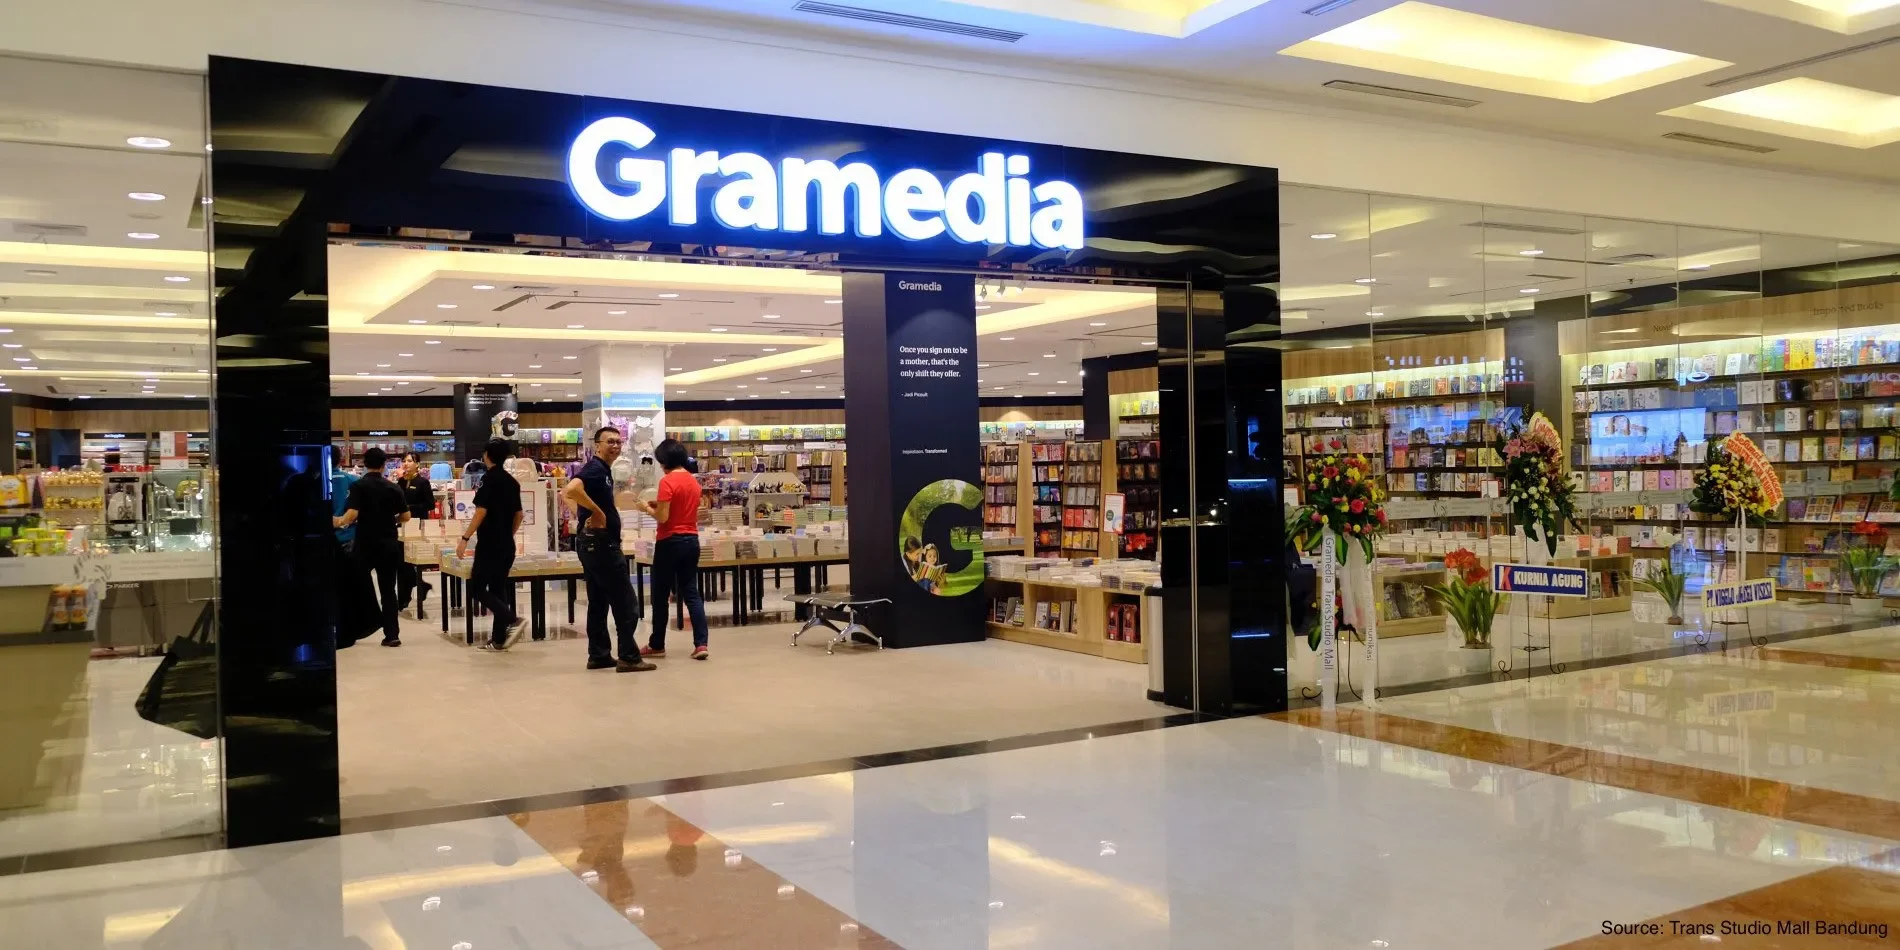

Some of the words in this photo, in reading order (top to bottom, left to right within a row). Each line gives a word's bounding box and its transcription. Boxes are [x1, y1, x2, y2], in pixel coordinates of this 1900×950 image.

[567, 116, 1084, 250] Gramedia
[898, 280, 942, 291] Gramedia
[1857, 301, 1885, 312] Books
[916, 347, 929, 355] you
[929, 346, 943, 355] sign
[905, 358, 931, 366] mother,
[931, 358, 948, 366] that's
[948, 358, 960, 366] the
[900, 370, 915, 379] only
[929, 370, 944, 379] they
[1324, 536, 1334, 583] Gramedia
[1514, 570, 1548, 586] KURNIA
[1551, 573, 1583, 588] AGUNG
[1324, 588, 1334, 614] Trans
[1324, 615, 1334, 645] Studio
[1324, 648, 1334, 670] Mall
